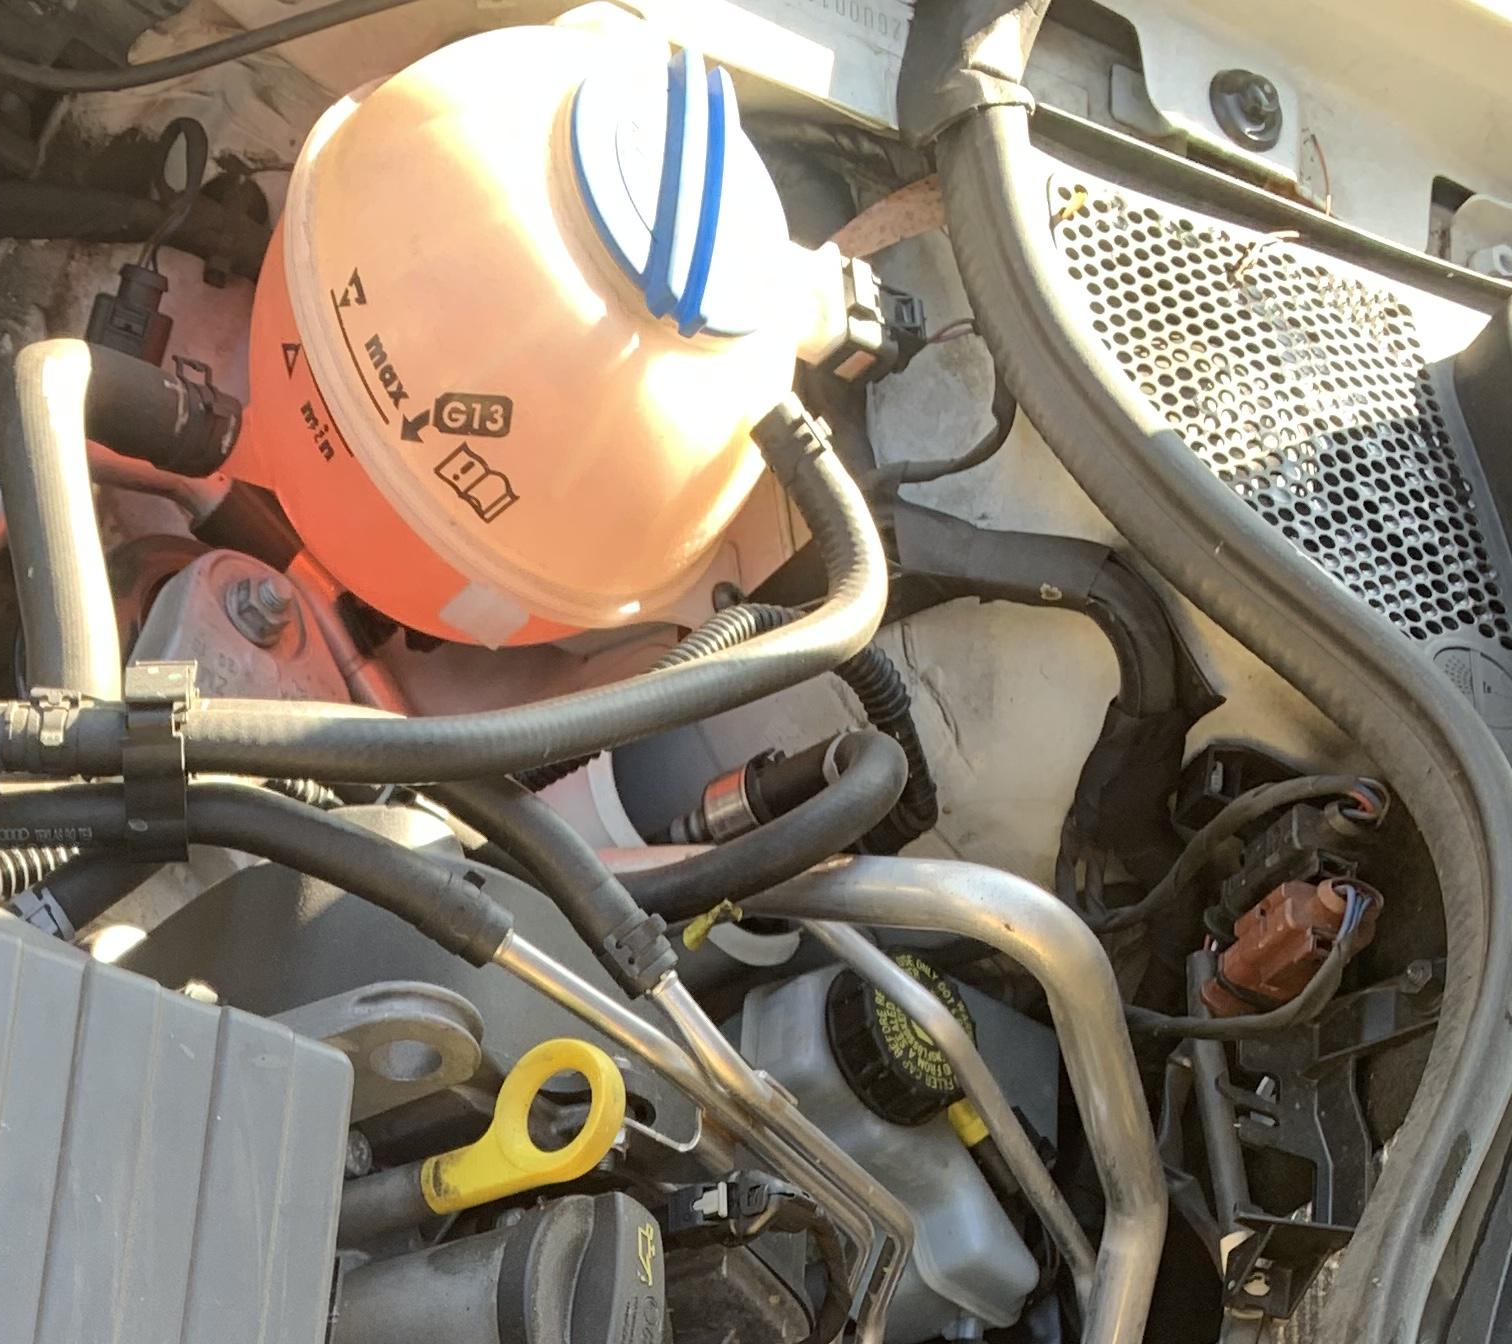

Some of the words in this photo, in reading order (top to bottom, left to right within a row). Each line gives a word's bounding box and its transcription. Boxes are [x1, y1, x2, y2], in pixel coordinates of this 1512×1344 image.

[364, 333, 410, 411] max
[299, 400, 336, 464] min
[441, 402, 505, 433] G13
